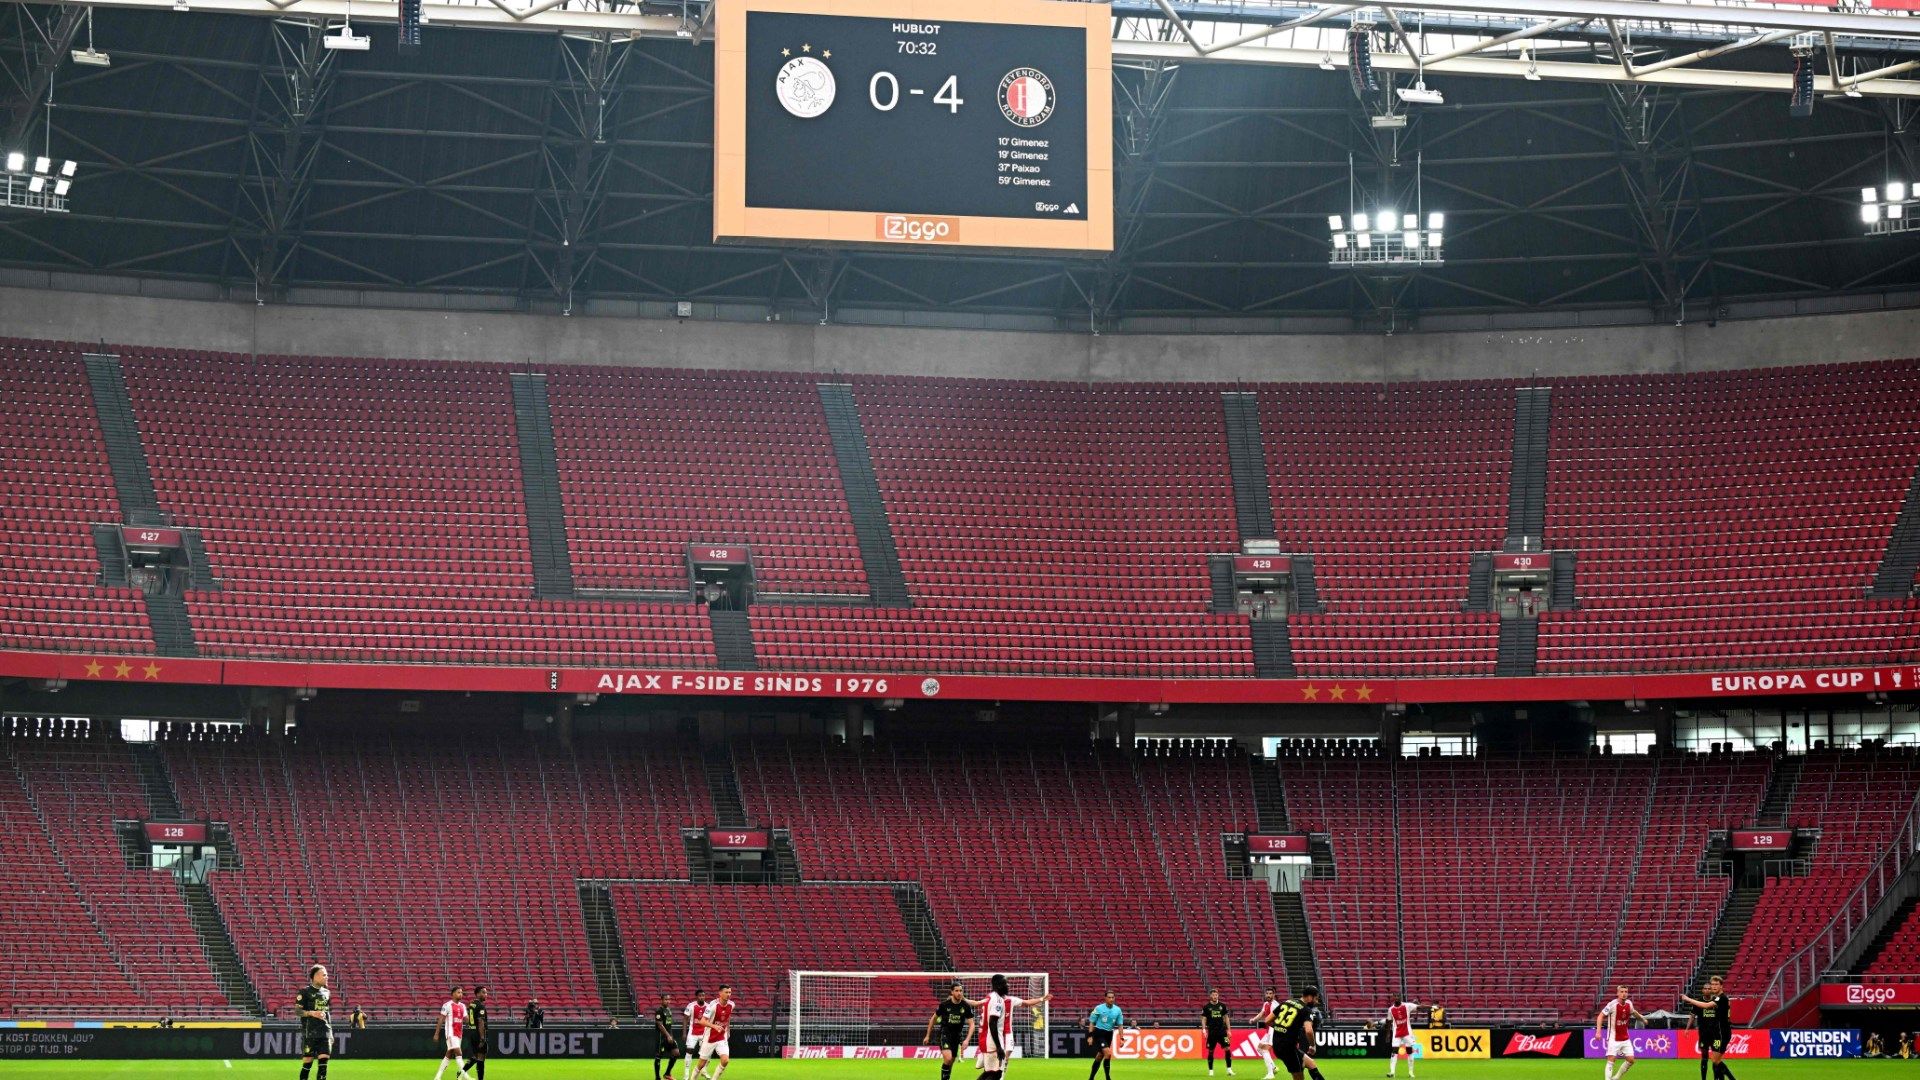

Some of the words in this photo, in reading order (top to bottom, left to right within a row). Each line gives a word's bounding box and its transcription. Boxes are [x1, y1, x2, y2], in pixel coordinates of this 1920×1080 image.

[892, 23, 941, 34] HUBLOT
[897, 41, 937, 55] 70:32
[778, 58, 805, 84] AJAX
[1002, 69, 1051, 90] FEYENOORD
[869, 71, 900, 111] 0
[933, 75, 964, 114] 4
[1002, 105, 1052, 125] ROTTERDAM
[1011, 138, 1049, 148] Gimenez
[1010, 151, 1049, 160] Gimenez
[1012, 163, 1040, 173] Paixao
[1013, 177, 1051, 187] Gimenez
[141, 532, 160, 541] 427
[709, 549, 728, 559] 428
[1252, 560, 1271, 569] 429
[1513, 557, 1532, 566] 430
[597, 674, 662, 693] AJAX
[672, 675, 745, 691] F-SIDE
[754, 677, 822, 692] SINDS
[835, 678, 888, 693] 1976
[1711, 674, 1806, 692] EUROPA
[1816, 671, 1864, 688] CUP
[164, 827, 184, 837] 126
[728, 834, 747, 844] 127
[1268, 839, 1287, 849] 128
[1753, 835, 1773, 845] 129
[1273, 1003, 1298, 1028] 33
[6, 1033, 29, 1042] KOST
[32, 1033, 68, 1042] GOKKEN
[71, 1034, 94, 1043] JOU?
[498, 1032, 604, 1055] UNIBET
[764, 1034, 787, 1043] KST
[1315, 1032, 1378, 1047] UNIBET
[1514, 1034, 1556, 1051] Bud
[1780, 1031, 1851, 1044] VRIENDEN
[24, 1045, 37, 1054] OP
[64, 1045, 79, 1054] 18+
[1430, 1035, 1483, 1053] BLOX
[854, 1046, 889, 1059] Flink
[913, 1046, 943, 1059] Flin
[1789, 1043, 1843, 1058] LOTERIJ
